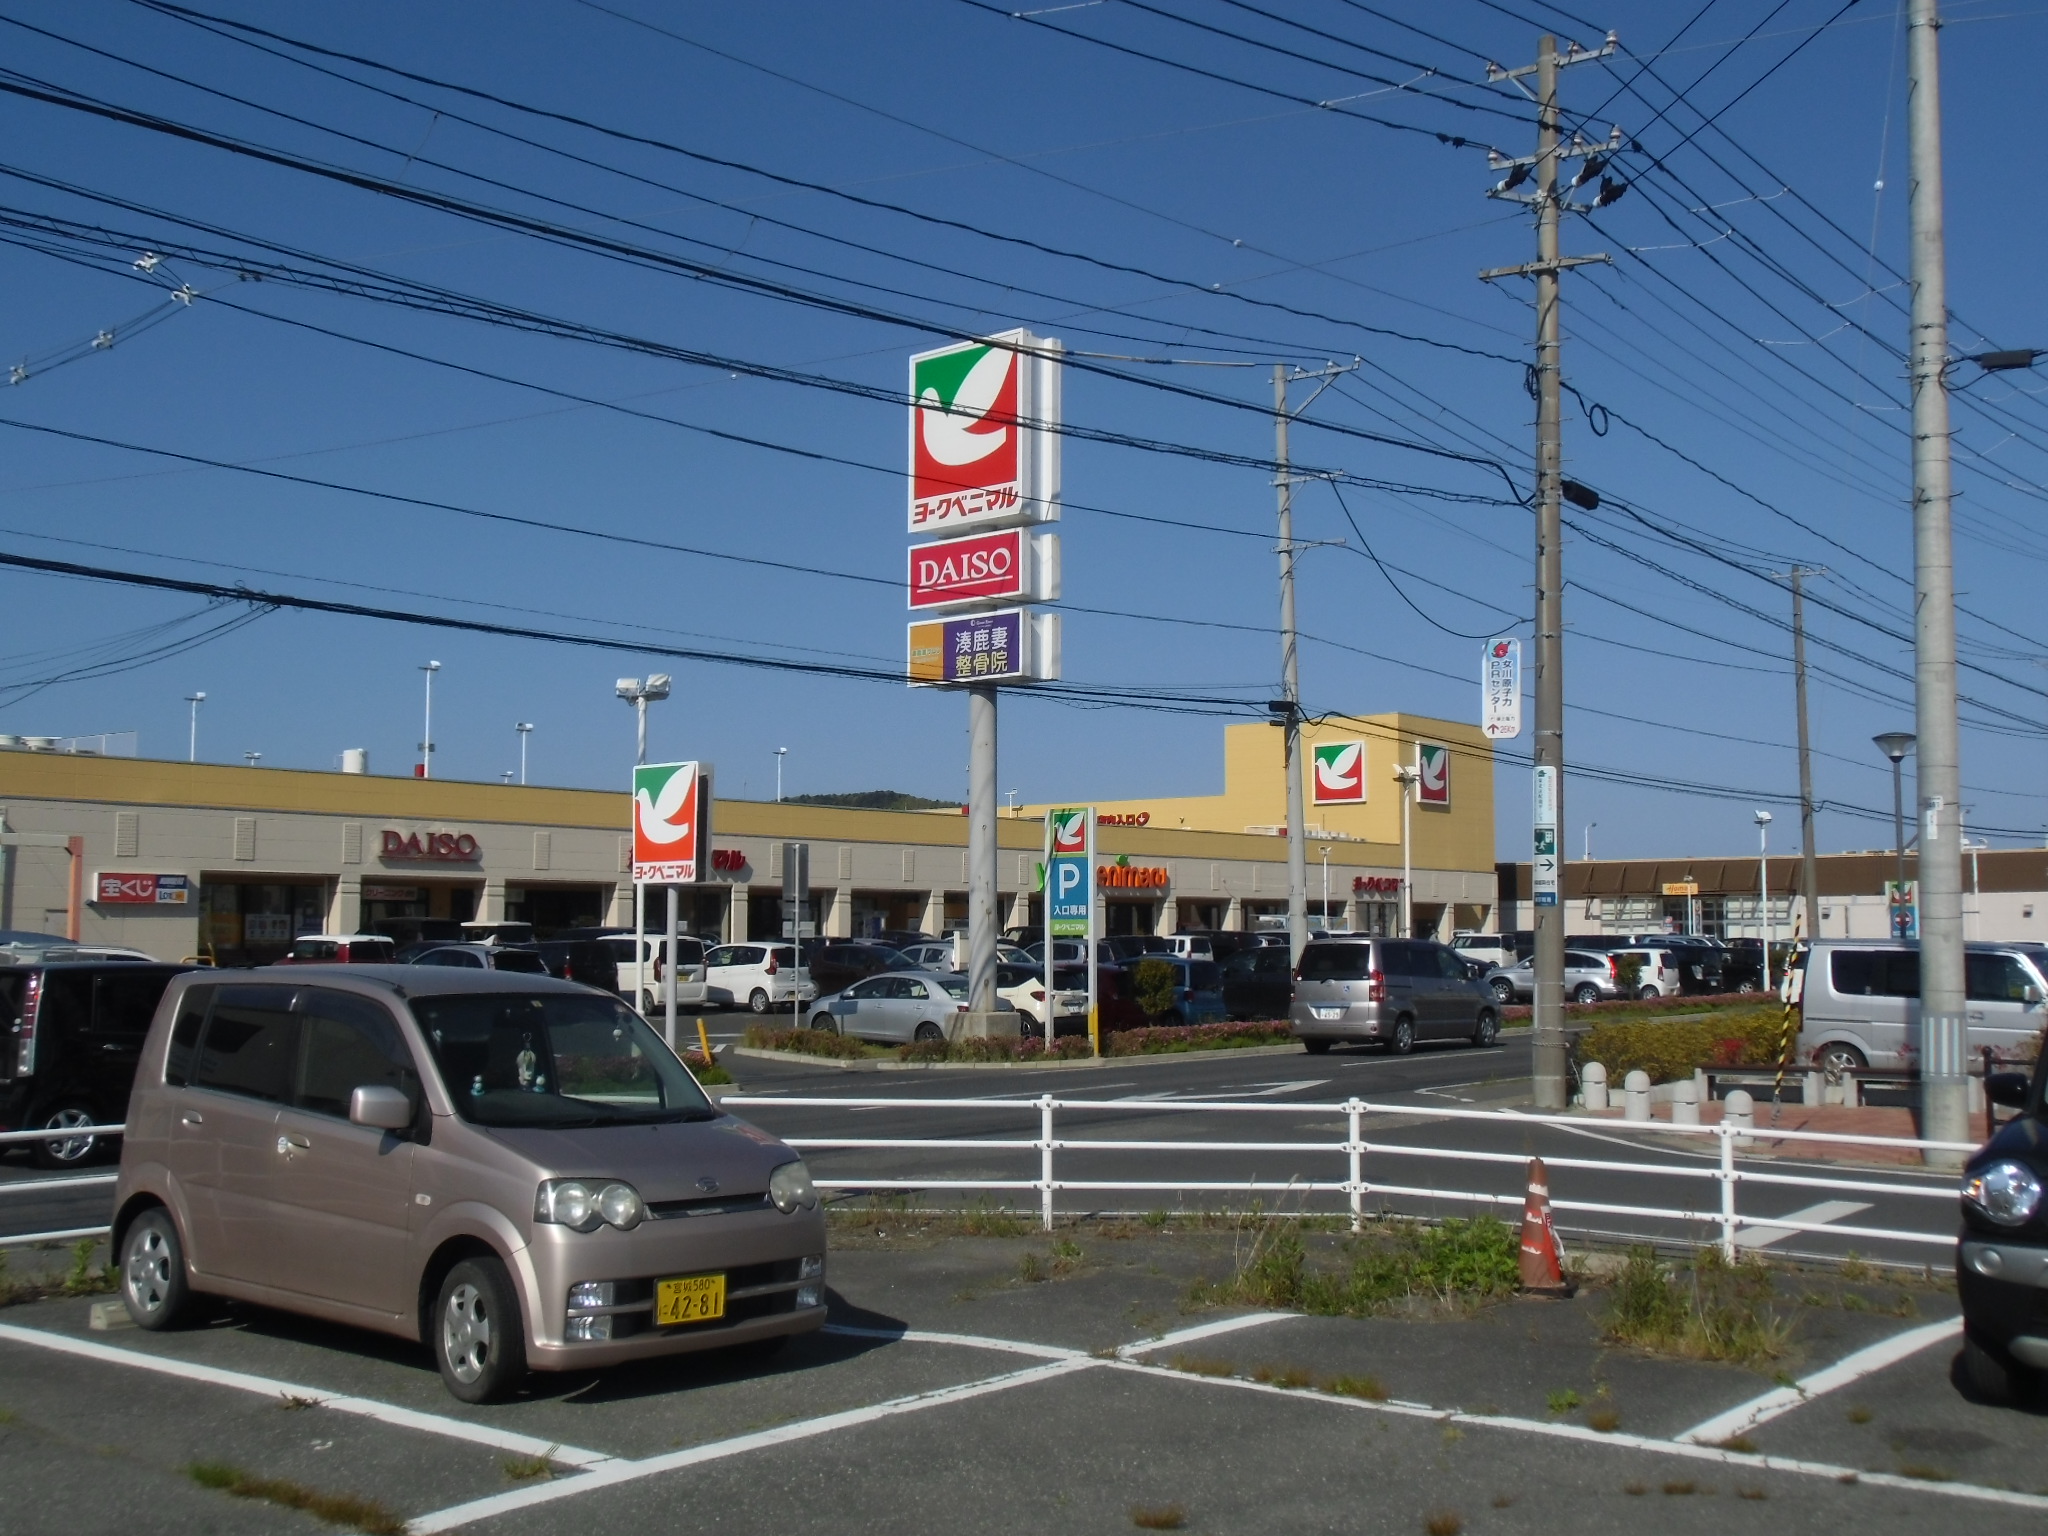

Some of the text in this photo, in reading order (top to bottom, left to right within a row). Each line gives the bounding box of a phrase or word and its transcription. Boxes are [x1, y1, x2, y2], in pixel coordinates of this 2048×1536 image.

[912, 486, 1019, 525] ヨークベニマル
[918, 547, 1012, 587] DAISO
[955, 626, 1008, 654] 湊鹿妻
[955, 650, 1008, 678] 整骨院
[1502, 659, 1513, 707] 女川原子力
[380, 830, 477, 856] DAISO
[633, 864, 695, 880] ヨークベニマル
[1058, 863, 1081, 900] P
[1096, 856, 1168, 888] enimaru
[100, 878, 154, 897] 宝くじ
[1053, 904, 1088, 916] 入口専用
[669, 1291, 719, 1320] 42-81
